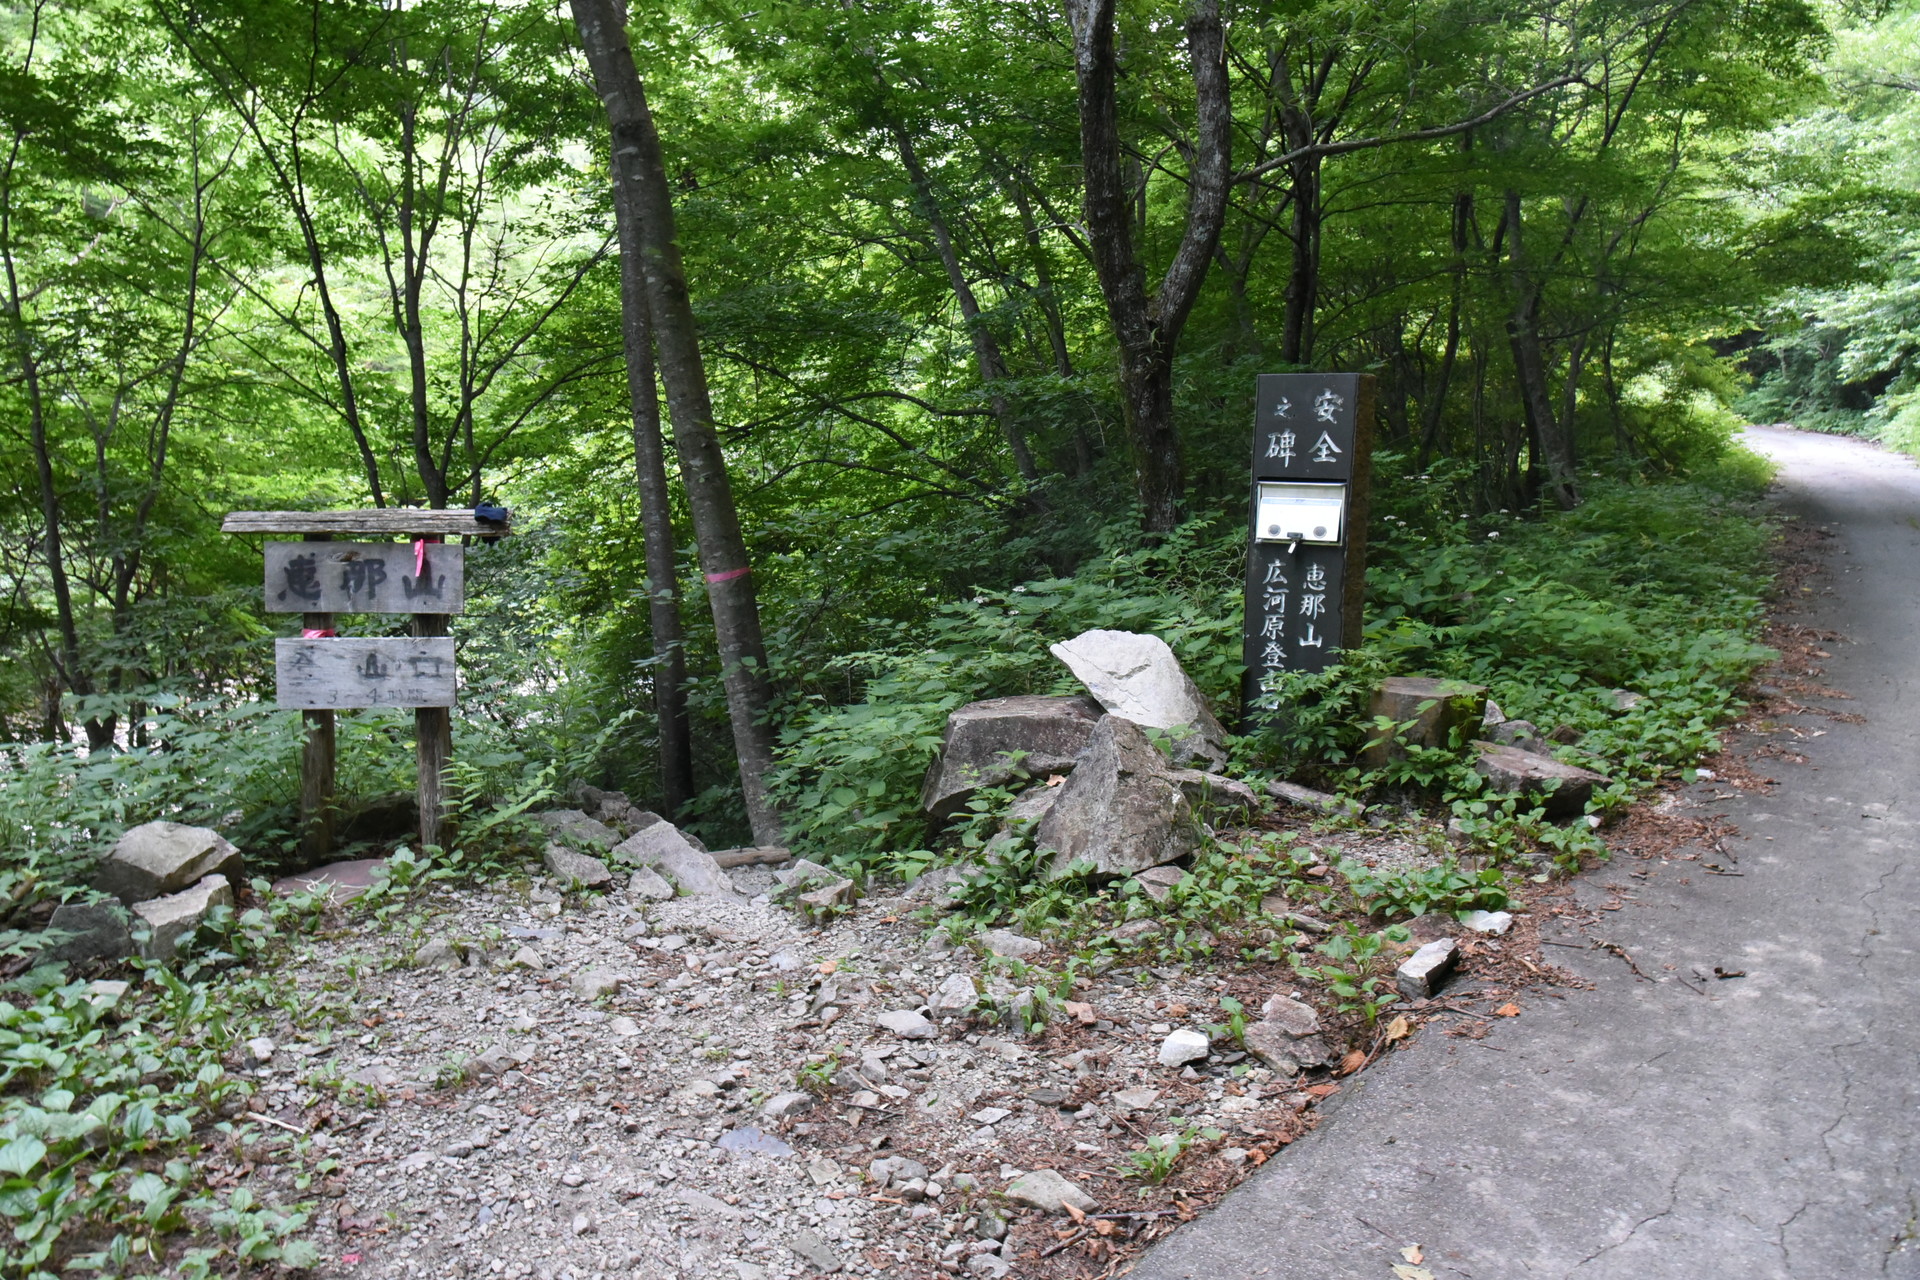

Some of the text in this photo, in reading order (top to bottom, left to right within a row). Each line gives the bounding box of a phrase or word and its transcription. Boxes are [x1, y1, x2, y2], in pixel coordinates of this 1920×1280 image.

[1264, 396, 1297, 468] 之碑
[1308, 388, 1344, 463] 安全
[1298, 562, 1328, 648] 恵那山
